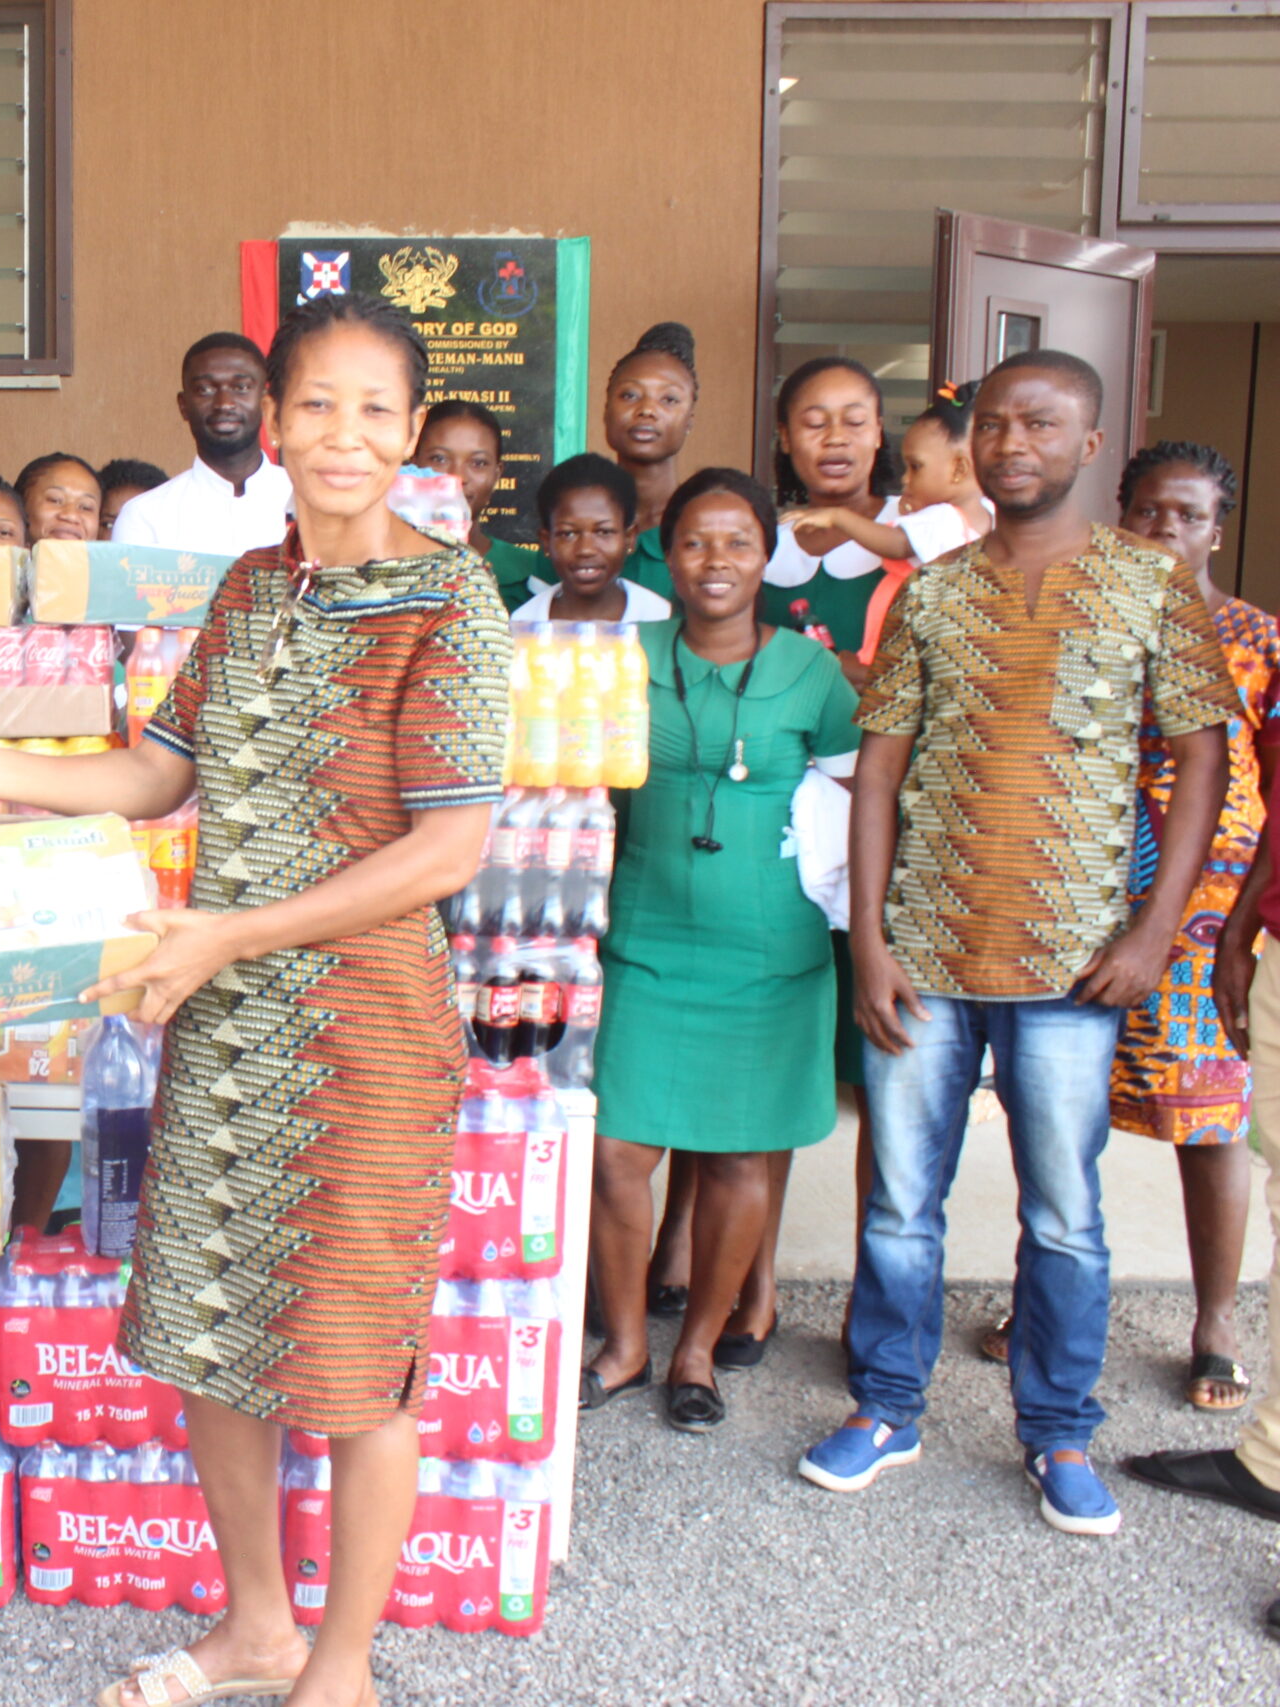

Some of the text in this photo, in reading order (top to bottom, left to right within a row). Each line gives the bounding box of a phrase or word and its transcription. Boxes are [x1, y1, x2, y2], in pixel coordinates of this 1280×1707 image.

[451, 322, 475, 336] OF
[479, 322, 519, 337] GOD
[426, 340, 509, 350] OMMISSIONED BY
[29, 1057, 51, 1076] 24
[53, 1378, 143, 1391] MINERAL WATER
[75, 1410, 91, 1422] 15
[108, 1405, 148, 1422] 750ml
[124, 1547, 161, 1561] WATER
[95, 1576, 110, 1589] 15
[126, 1573, 166, 1591] 750ml
